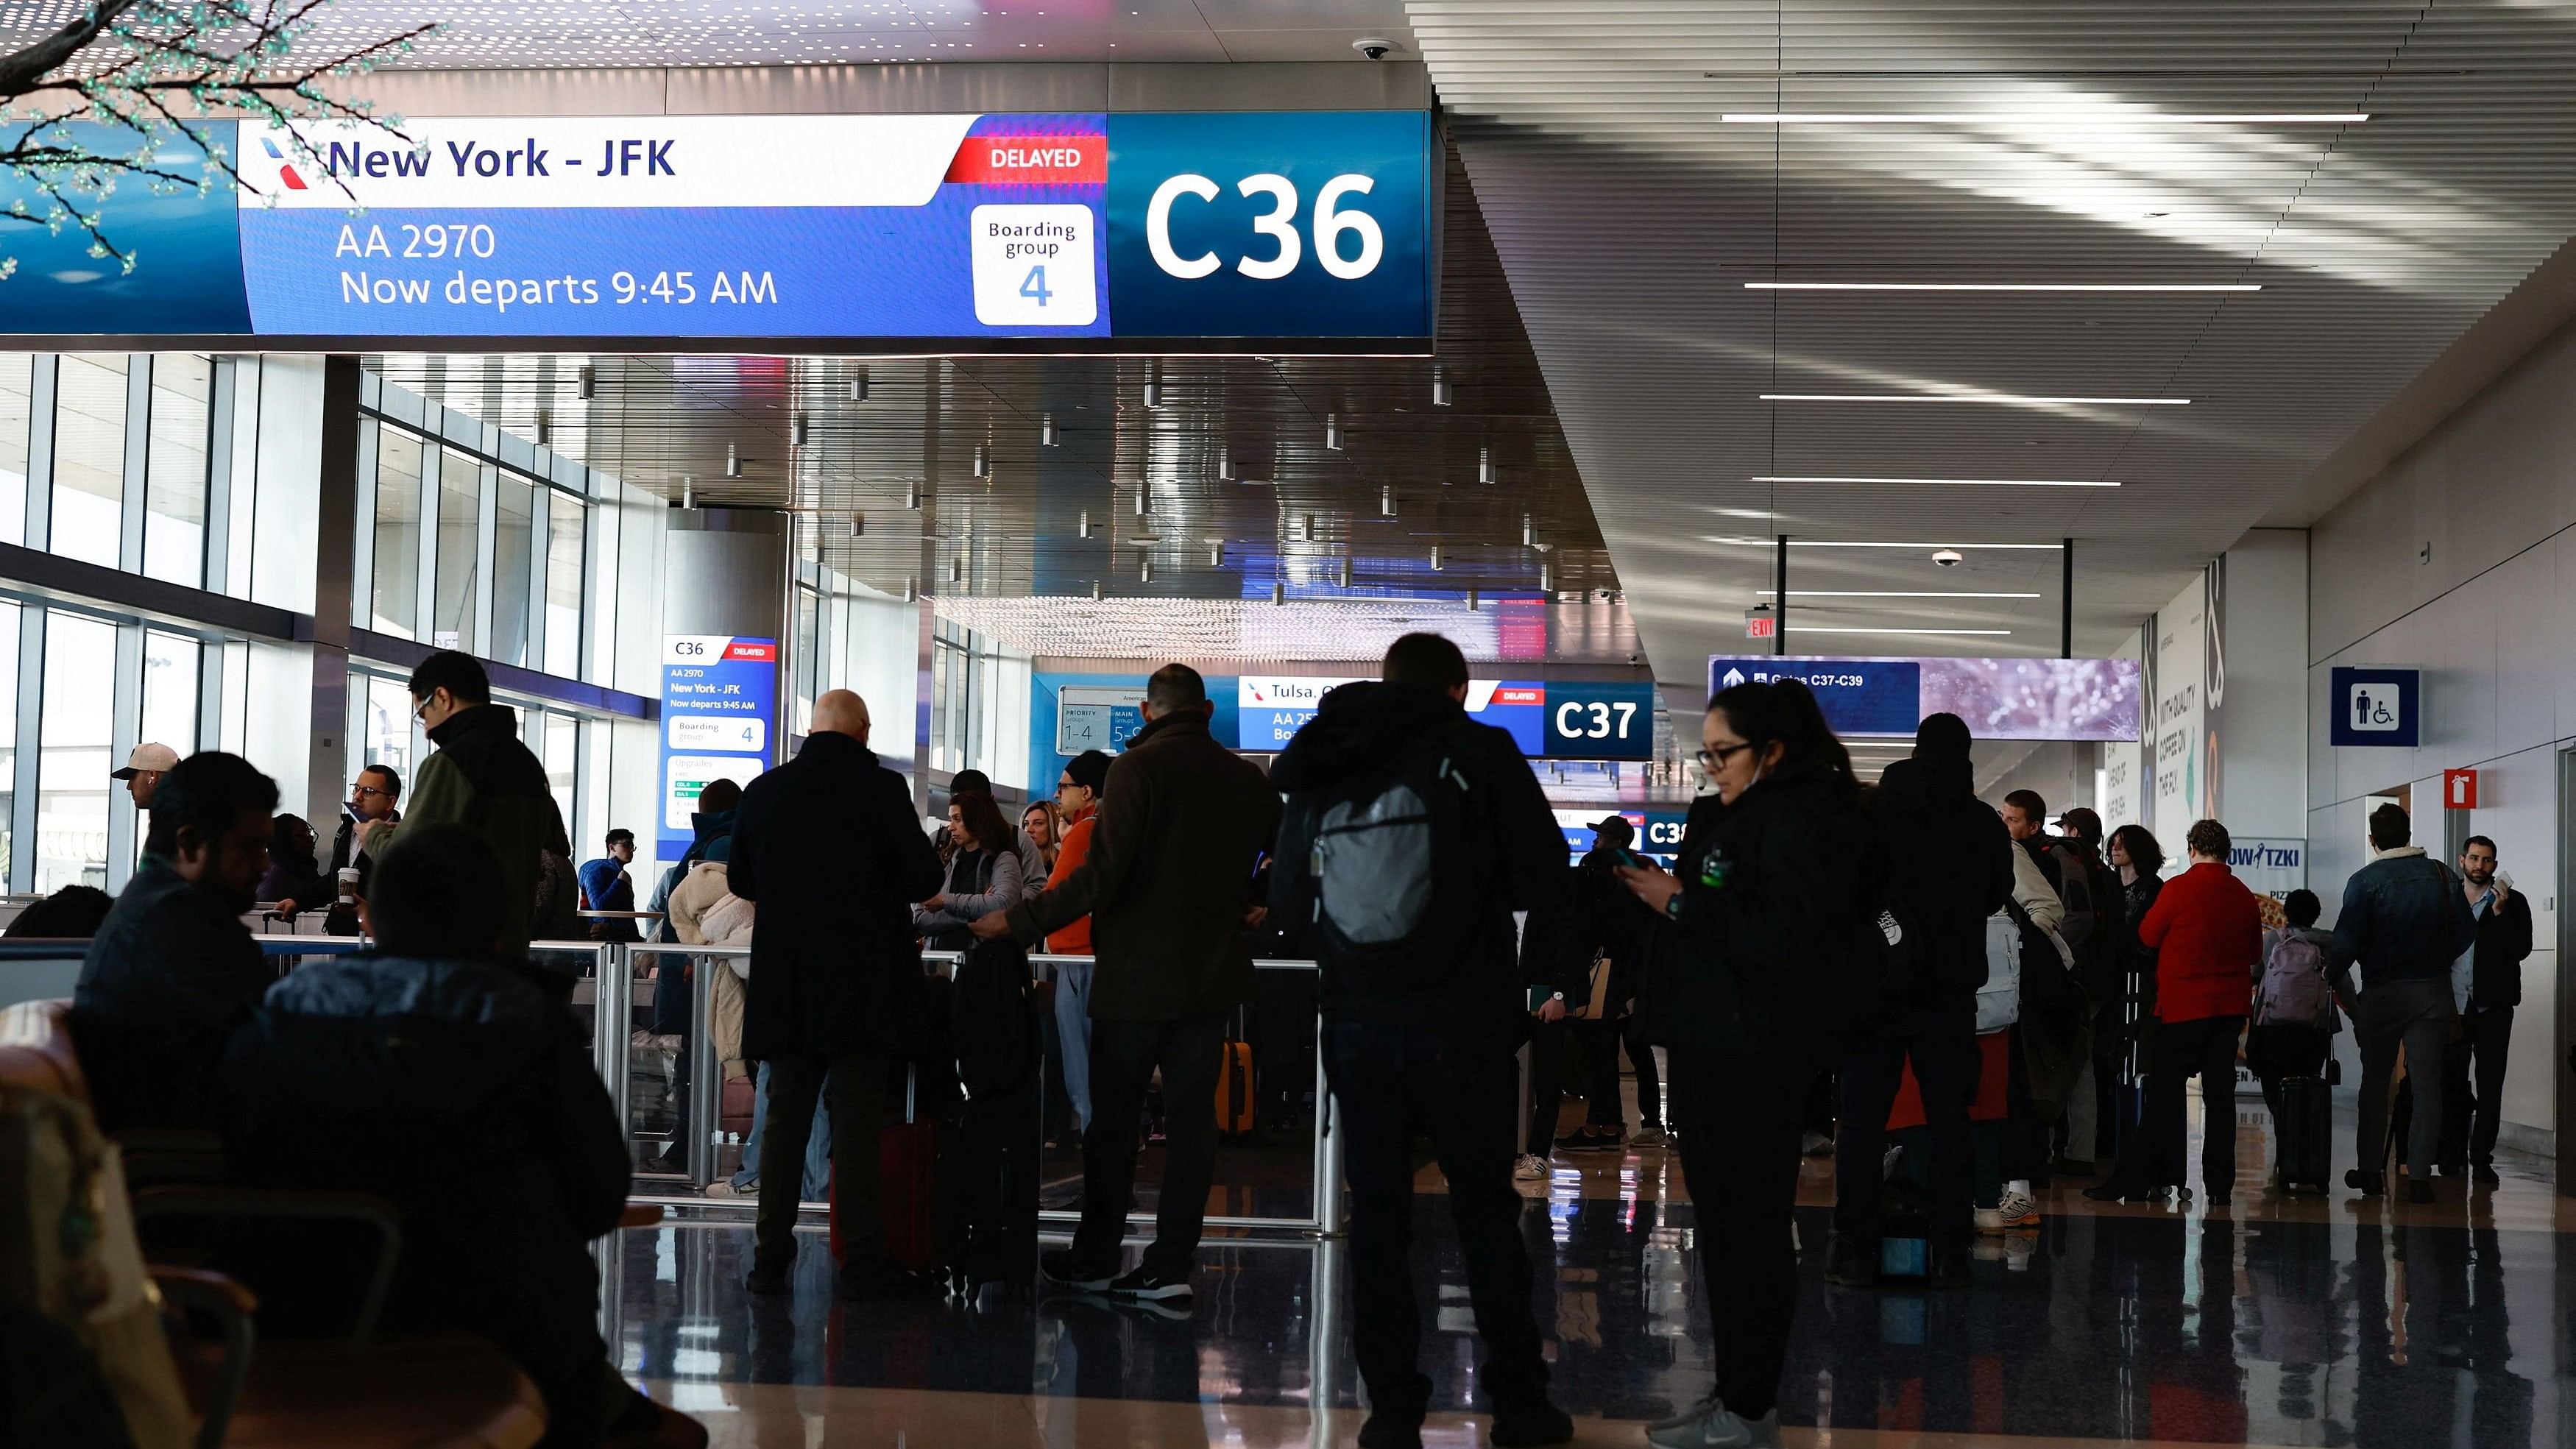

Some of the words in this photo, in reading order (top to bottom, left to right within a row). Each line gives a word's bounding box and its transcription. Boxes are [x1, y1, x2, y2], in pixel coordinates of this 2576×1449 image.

[328, 141, 432, 178] New
[447, 138, 550, 178] York
[597, 138, 676, 178] JFK
[991, 148, 1081, 169] DELAYED
[989, 222, 1075, 241] Boarding
[1146, 173, 1384, 280] C36
[335, 224, 391, 258] AA
[402, 224, 495, 259] 2970
[1005, 240, 1059, 259] group
[342, 272, 431, 305] Now
[445, 269, 598, 313] departs
[612, 271, 696, 305] 9:45
[710, 270, 779, 305] AM
[1019, 265, 1053, 308] 4
[1752, 618, 1774, 636] EXIT
[676, 642, 704, 655] C36
[734, 648, 765, 656] DELAYED
[684, 670, 704, 678] 2970
[1811, 675, 1864, 687] C37-C39
[670, 684, 693, 693] New
[695, 684, 716, 695] York
[723, 685, 740, 695] JFK
[1272, 684, 1317, 698] Tulsa,
[1504, 692, 1535, 701] DELAYED
[670, 700, 689, 708] Now
[690, 699, 721, 711] departs
[723, 701, 740, 709] 9:45
[741, 701, 755, 710] AM
[2173, 683, 2195, 719] QUALITY
[1273, 712, 1294, 726] AA
[1297, 712, 1319, 726] 25
[1556, 701, 1637, 739] C37
[679, 722, 719, 732] Boarding
[679, 732, 704, 742] group
[741, 726, 754, 743] 4
[675, 759, 712, 768] Upgrades
[1568, 837, 1582, 846] AM
